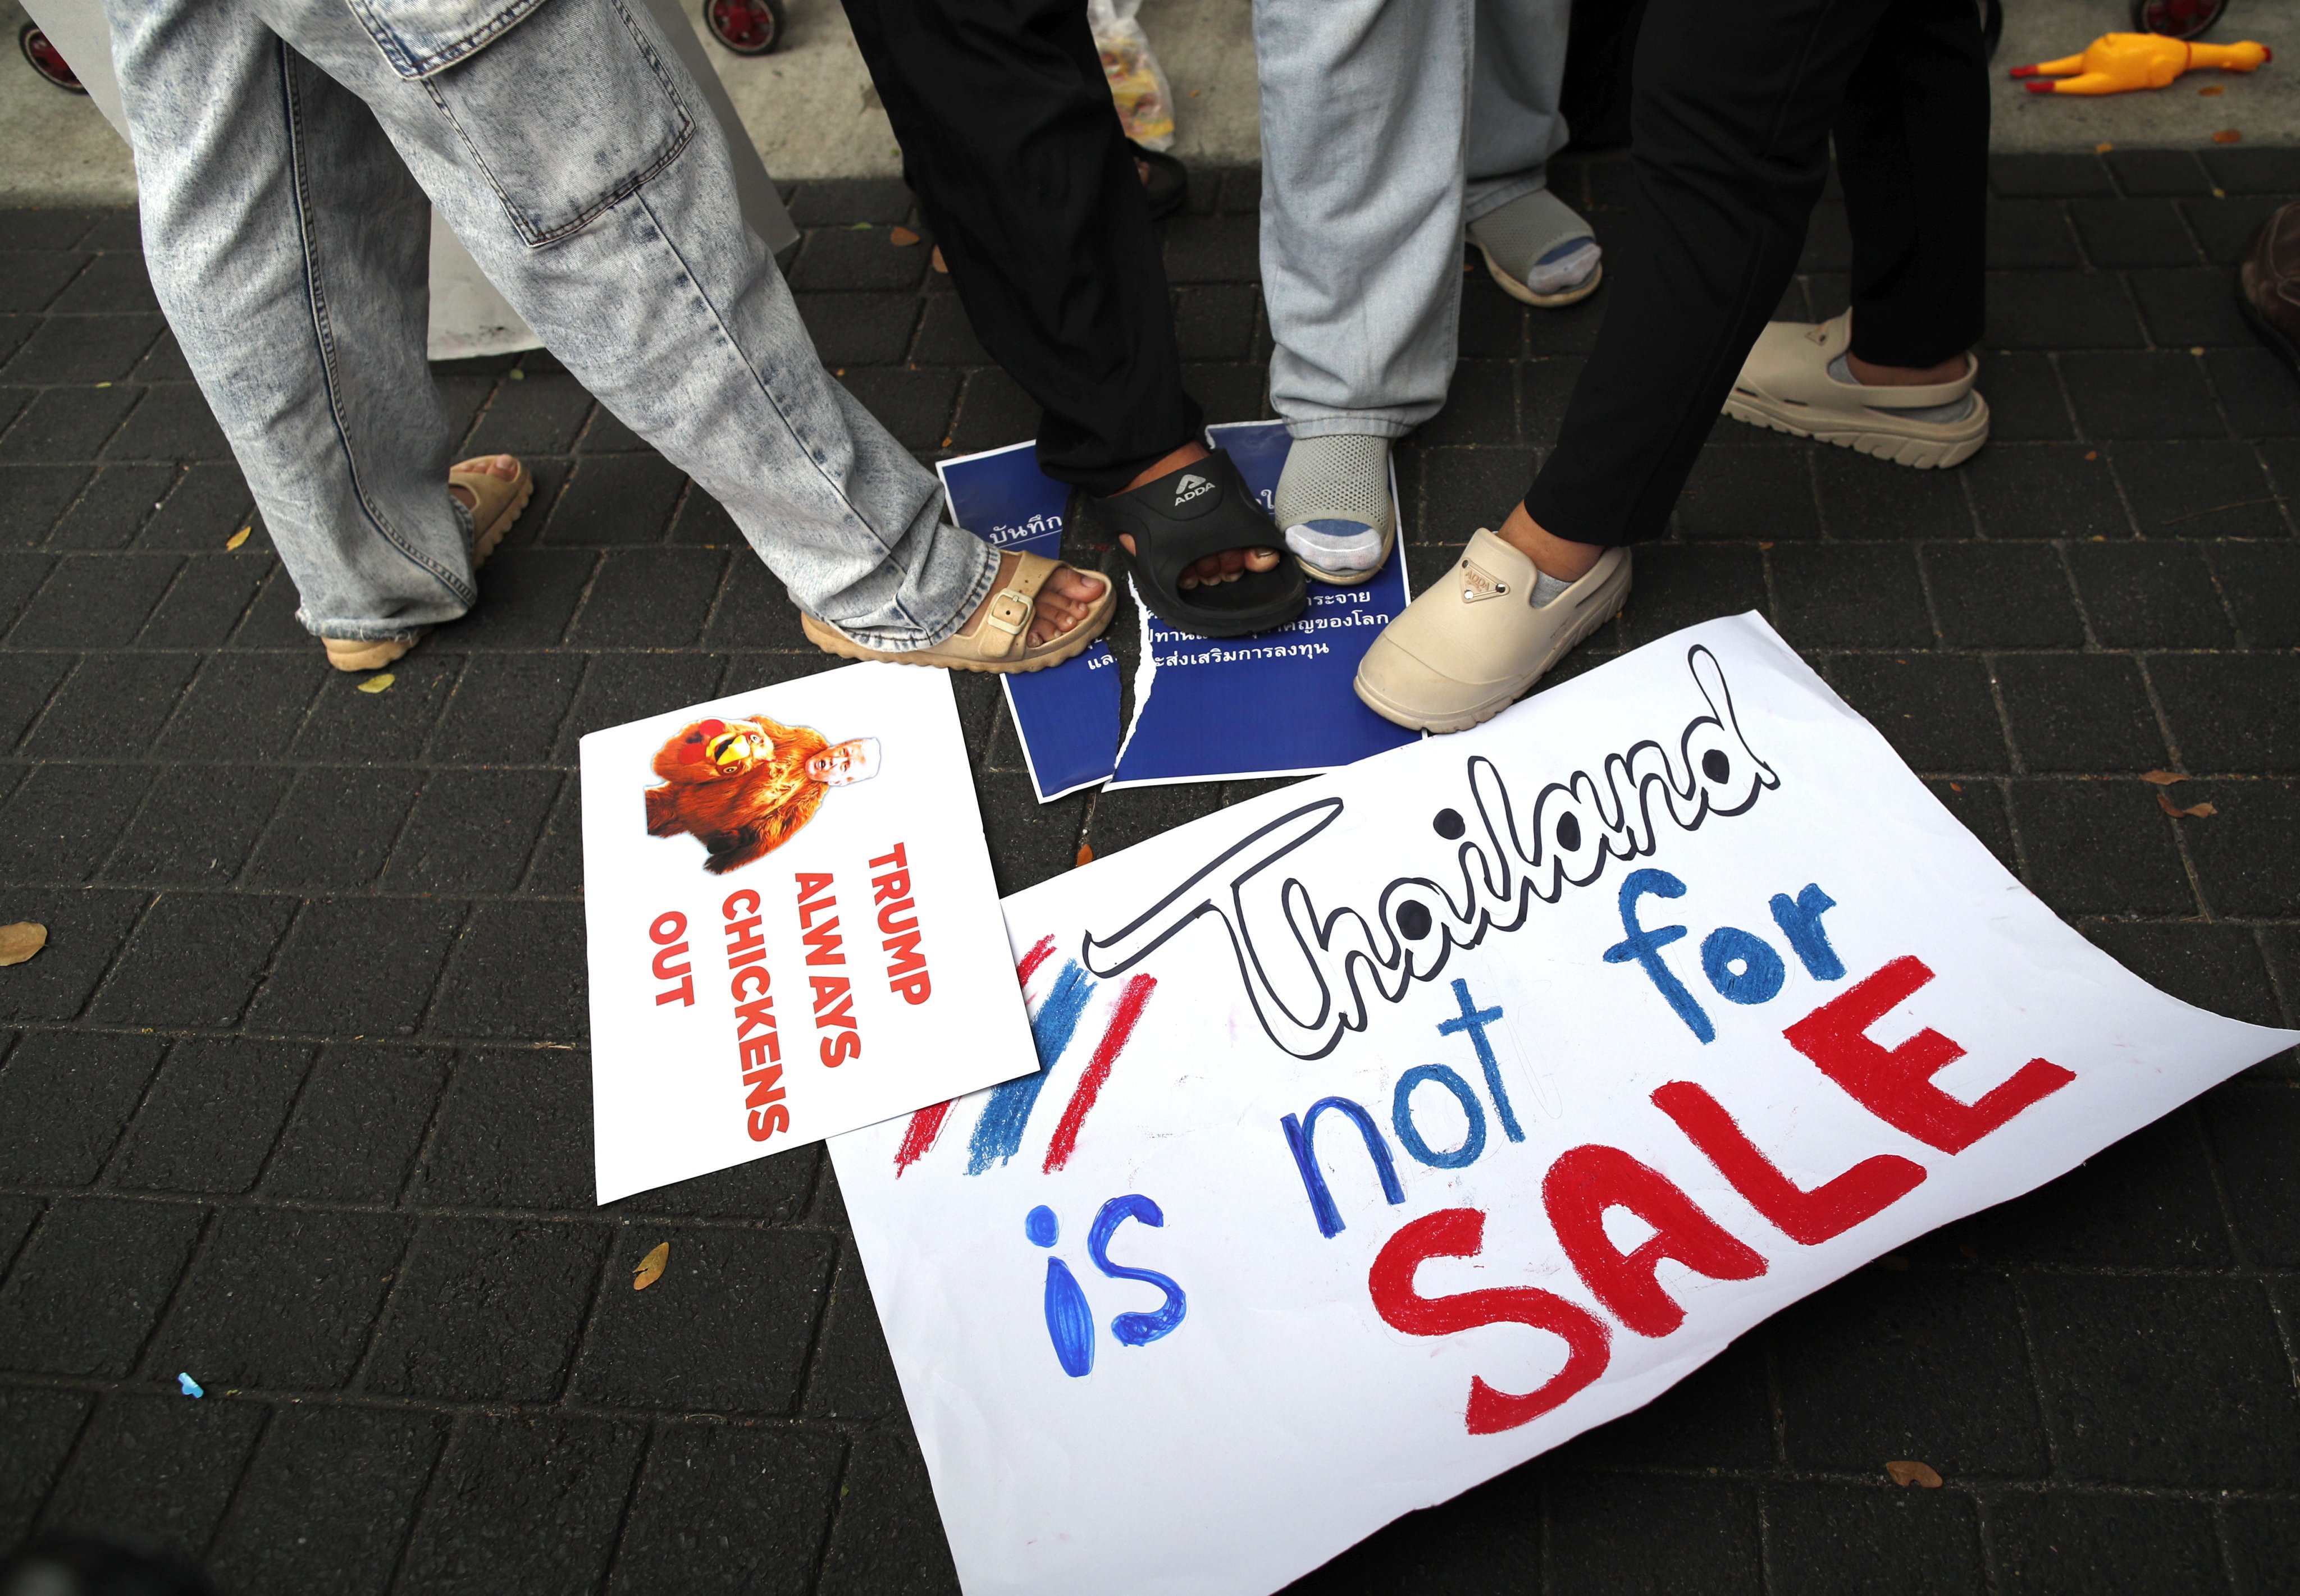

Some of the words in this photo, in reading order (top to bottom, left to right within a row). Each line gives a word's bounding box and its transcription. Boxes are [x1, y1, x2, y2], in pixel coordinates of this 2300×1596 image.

[989, 514, 1063, 545] บันทึก
[1174, 482, 1216, 506] ADDA
[1465, 570, 1490, 591] ADDA
[869, 842, 932, 1005] TRUMP
[1083, 644, 1781, 1061] Thailand
[649, 911, 695, 1007] OUT
[722, 889, 790, 1142] CHICKENS
[795, 872, 861, 1068] ALWAYS
[1024, 1193, 1188, 1378] is
[1280, 978, 1526, 1240] not
[1603, 868, 1848, 1045] for
[1368, 955, 2077, 1435] SALE
